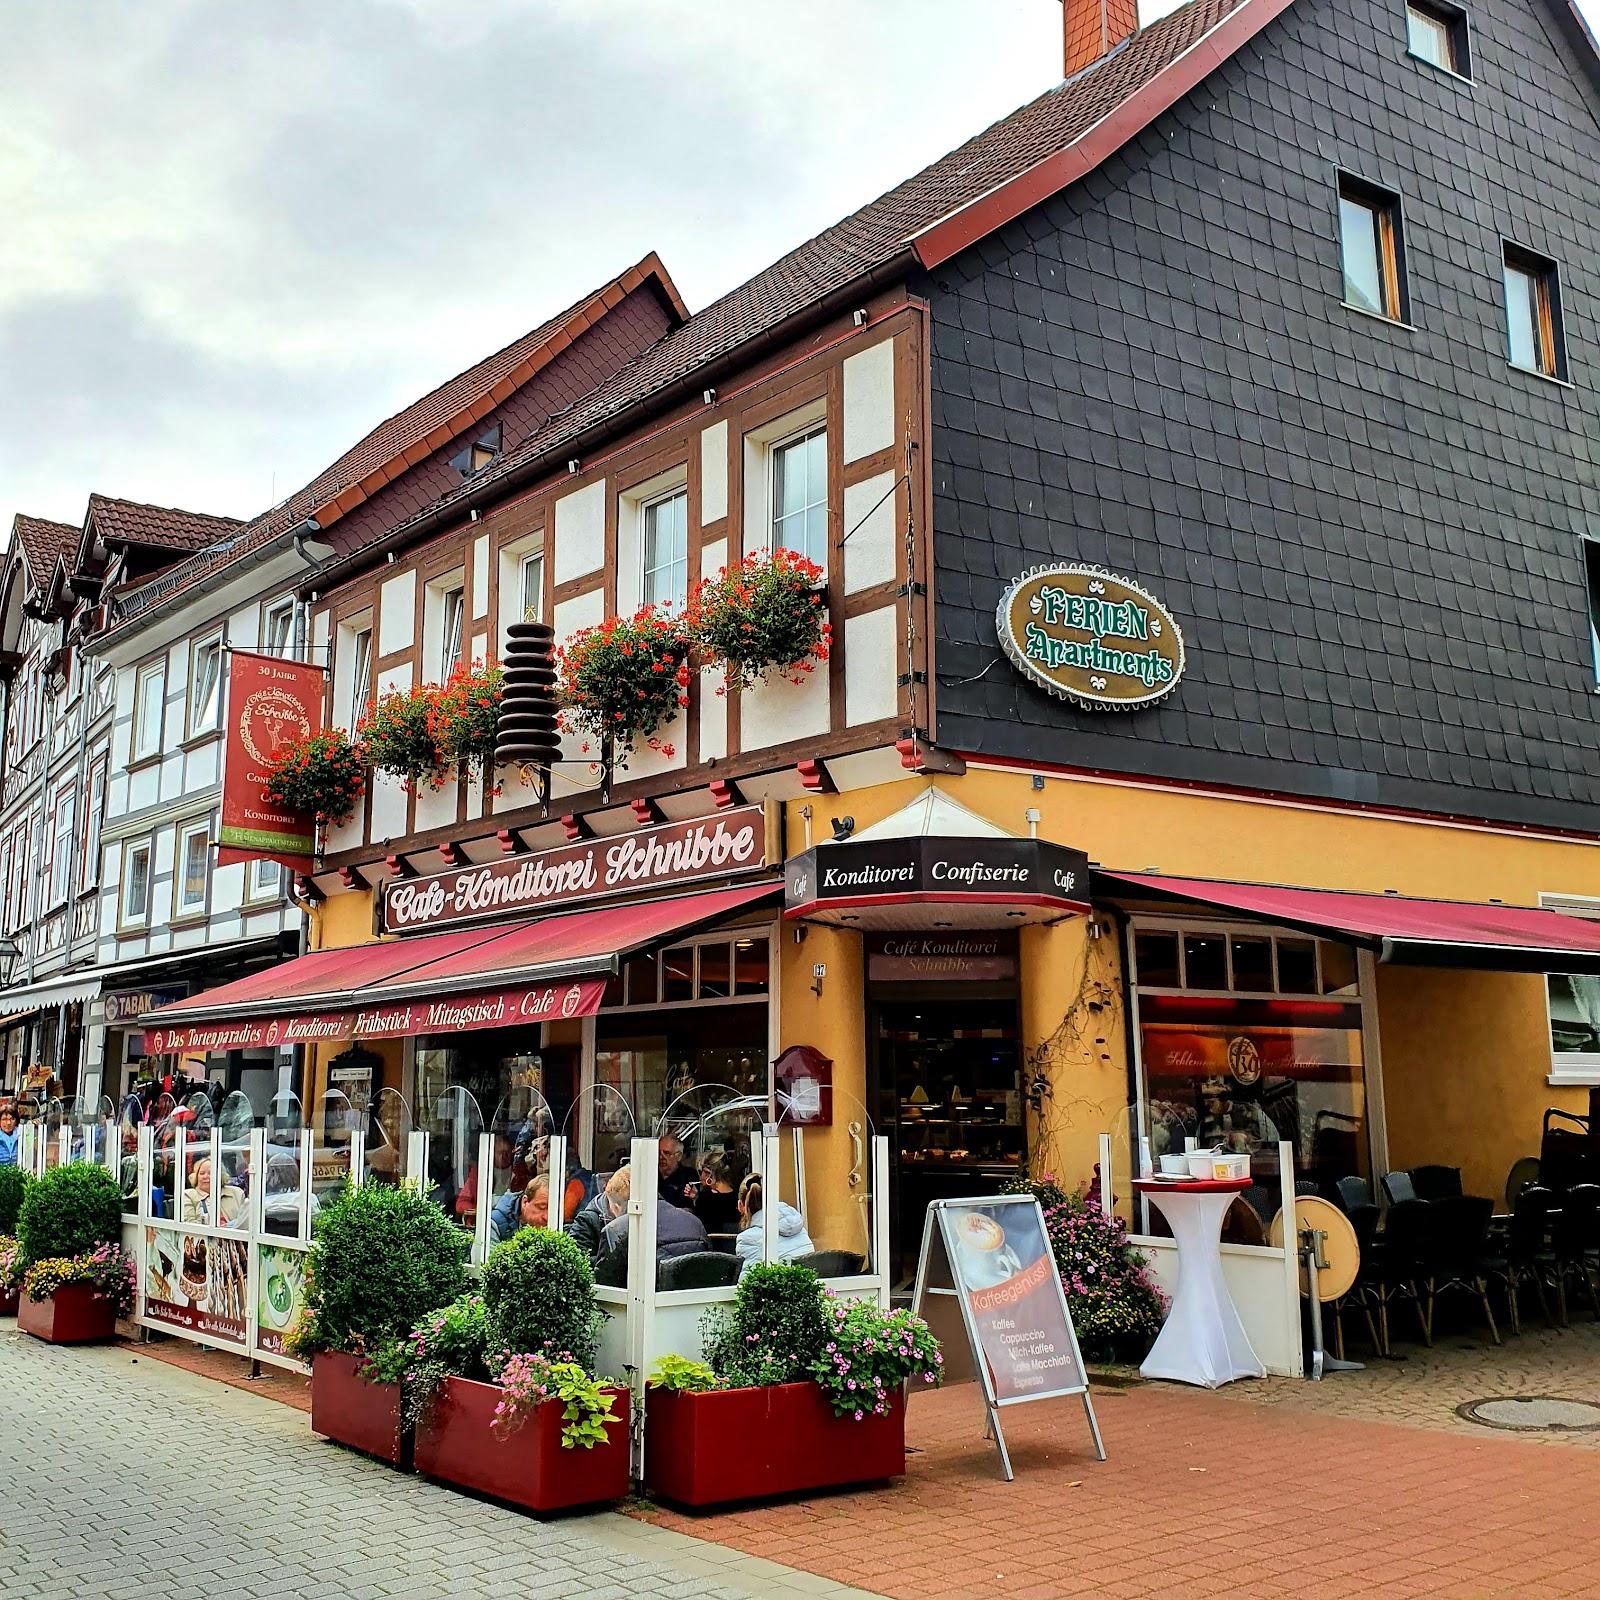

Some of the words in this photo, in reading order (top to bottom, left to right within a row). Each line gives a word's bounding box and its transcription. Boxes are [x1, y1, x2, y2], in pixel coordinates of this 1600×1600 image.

[1040, 586, 1149, 641] FERIEN
[1025, 621, 1173, 687] Apartments
[258, 666, 270, 676] 30
[390, 850, 598, 924] Cafe-Konditorei
[605, 820, 755, 886] Schnibbe
[823, 862, 915, 887] Konditorei
[931, 860, 1030, 885] Confiserie
[1053, 868, 1075, 892] Café
[793, 873, 808, 897] Café
[884, 940, 918, 957] Café
[921, 939, 998, 954] Konditorei
[118, 993, 153, 1016] TABAK
[283, 1016, 344, 1039] Konditorei
[352, 1007, 413, 1035] Frühstück
[423, 996, 505, 1030] Mittagstisch
[520, 989, 558, 1016] Café
[166, 1030, 184, 1049] Das
[187, 1023, 262, 1049] Tortenparadies
[972, 1263, 1048, 1312] Kaffeegenuss!
[992, 1318, 1016, 1330] Kaffee
[1000, 1329, 1045, 1346] Cappuccino
[1008, 1343, 1055, 1359] Milch-Kaffee
[1031, 1354, 1071, 1370] Macchiato
